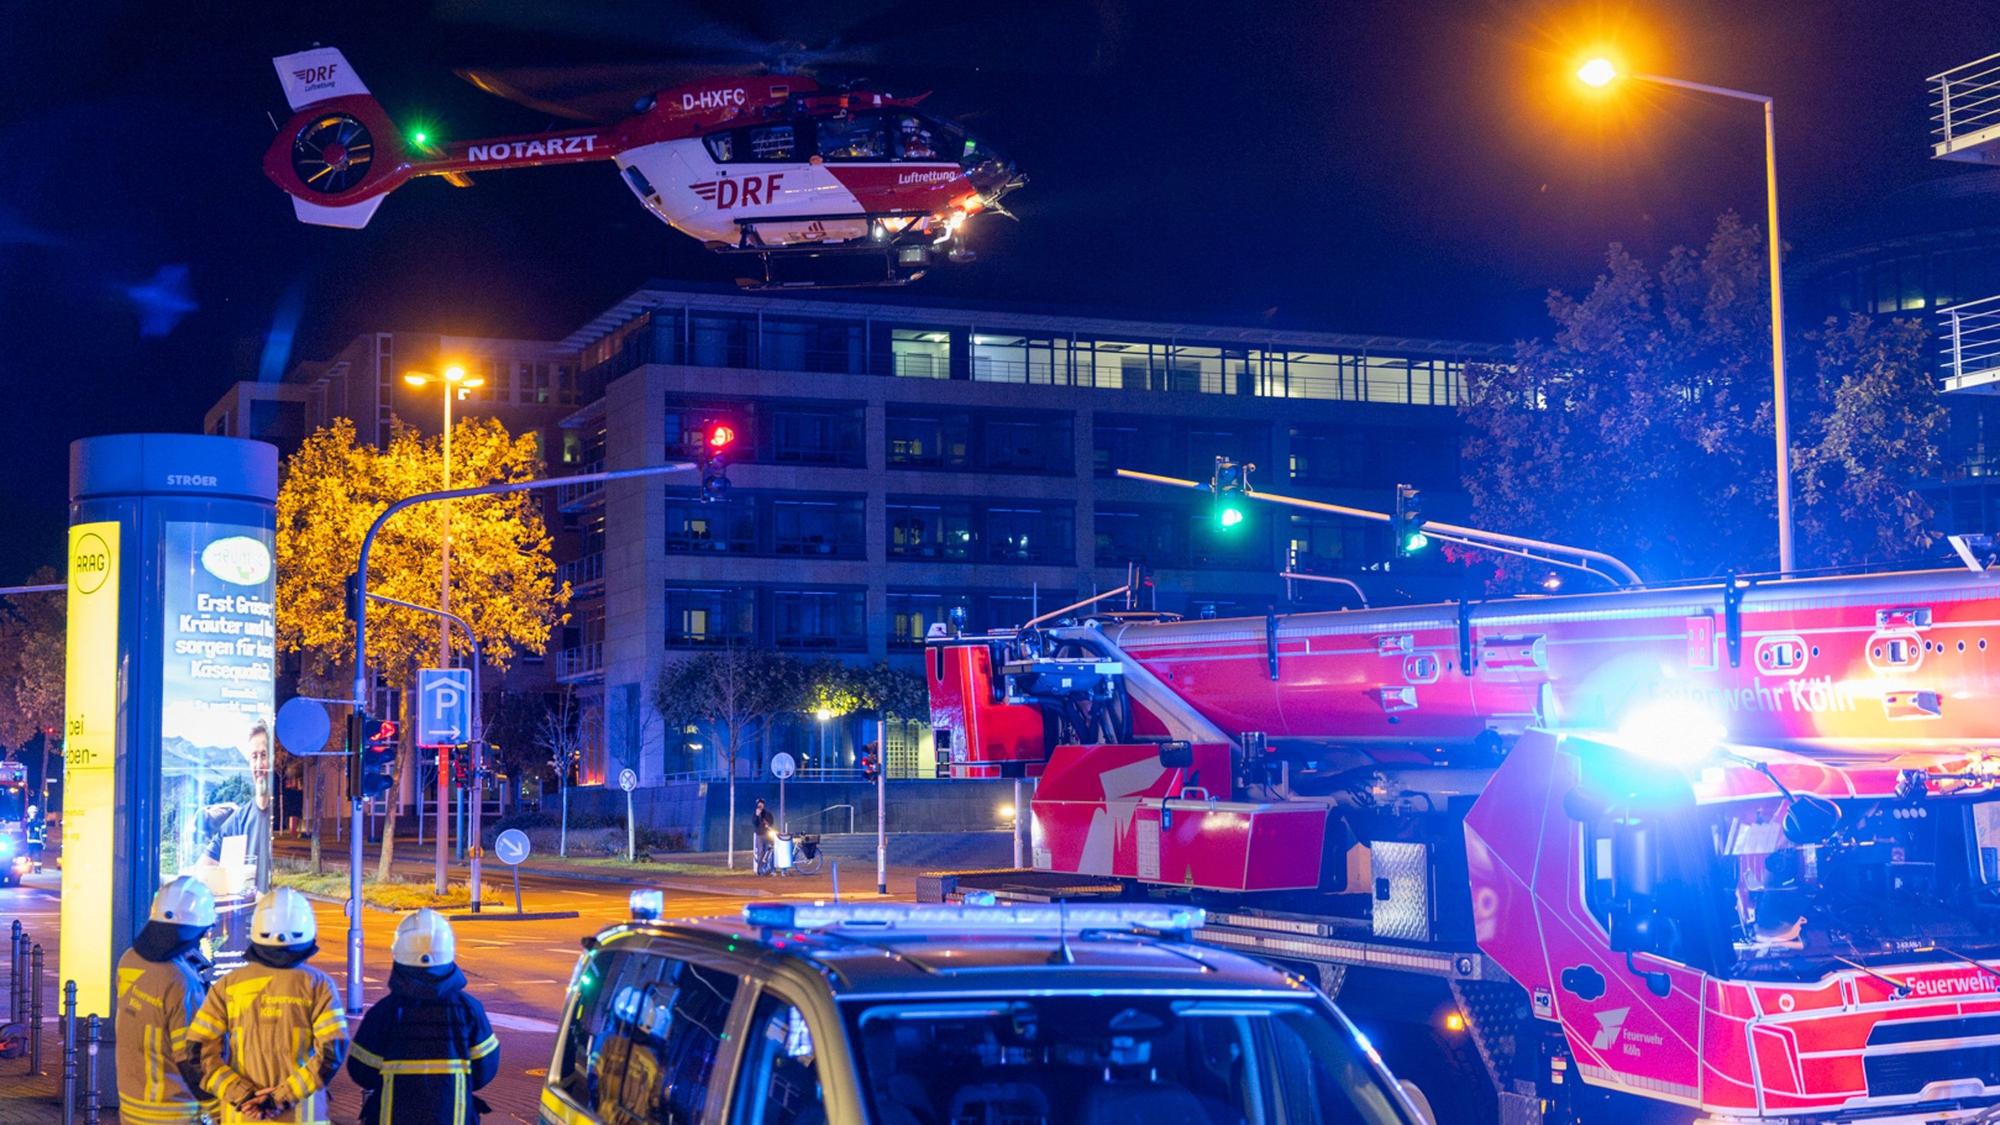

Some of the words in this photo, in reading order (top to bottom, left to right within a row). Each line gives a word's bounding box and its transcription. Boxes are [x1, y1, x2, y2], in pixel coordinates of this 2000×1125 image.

[305, 64, 337, 84] DRF
[682, 87, 746, 111] D-HXFC
[467, 134, 598, 163] NOTARZT
[898, 170, 958, 185] Luftrettung
[717, 173, 785, 210] DRF
[167, 474, 218, 487] STRÖER
[76, 553, 105, 572] ARAG
[196, 593, 235, 613] Erst
[179, 613, 243, 635] Kräuter
[174, 638, 235, 659] sorgen
[436, 688, 458, 719] P
[1788, 674, 1857, 714] Köln
[1905, 970, 1996, 997] Feuerwehr
[1622, 1027, 1664, 1047] Feuerwehr
